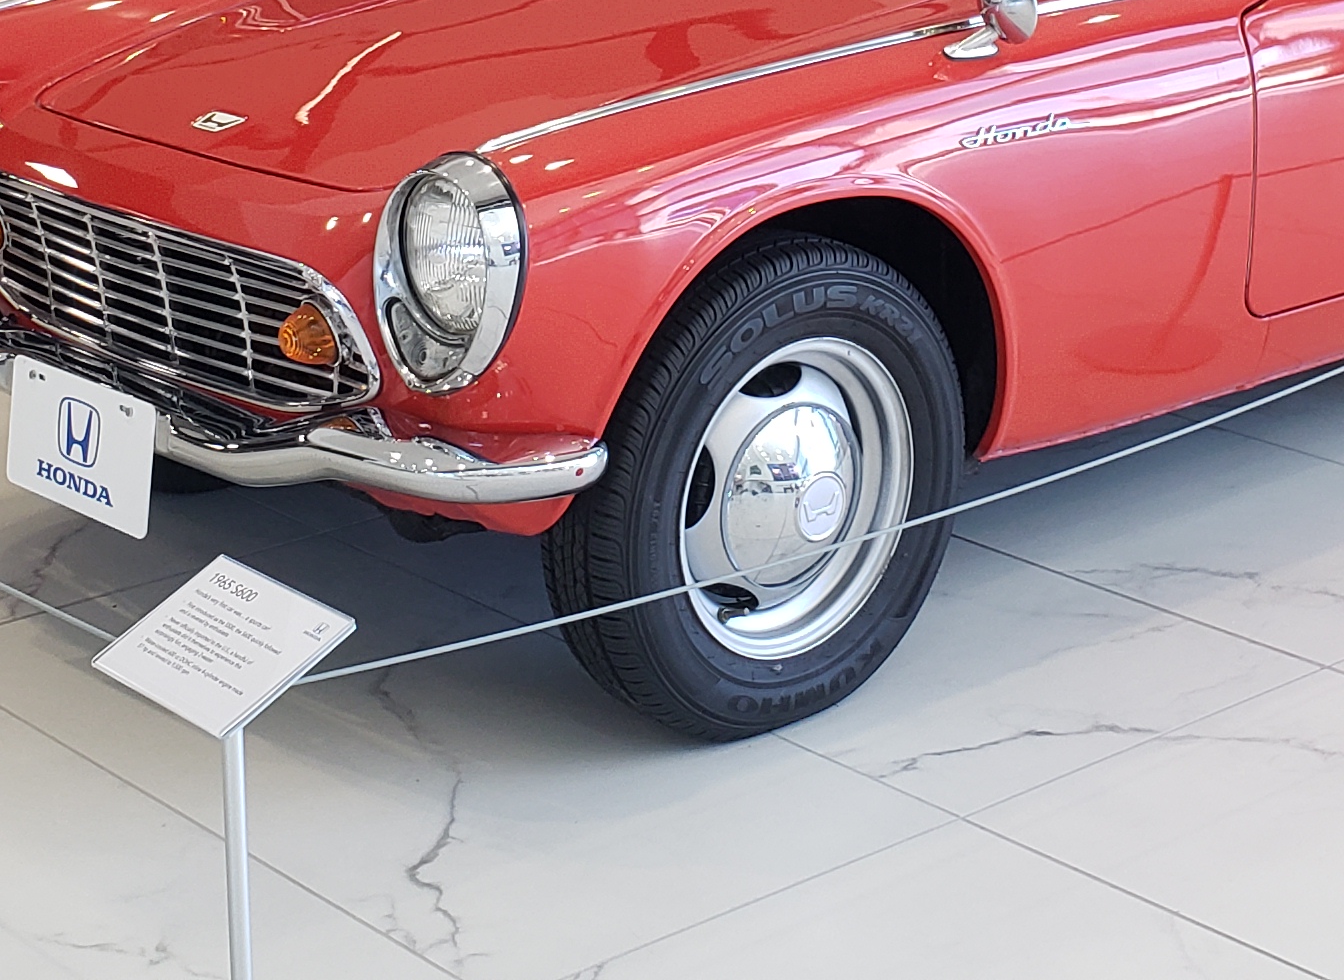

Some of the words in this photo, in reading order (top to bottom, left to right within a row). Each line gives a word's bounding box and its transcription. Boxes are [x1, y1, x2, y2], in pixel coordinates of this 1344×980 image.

[959, 112, 1080, 149] Honda
[700, 284, 860, 390] SOLUS
[36, 458, 114, 508] HONDA
[208, 572, 236, 590] 1965
[229, 583, 258, 602] S600
